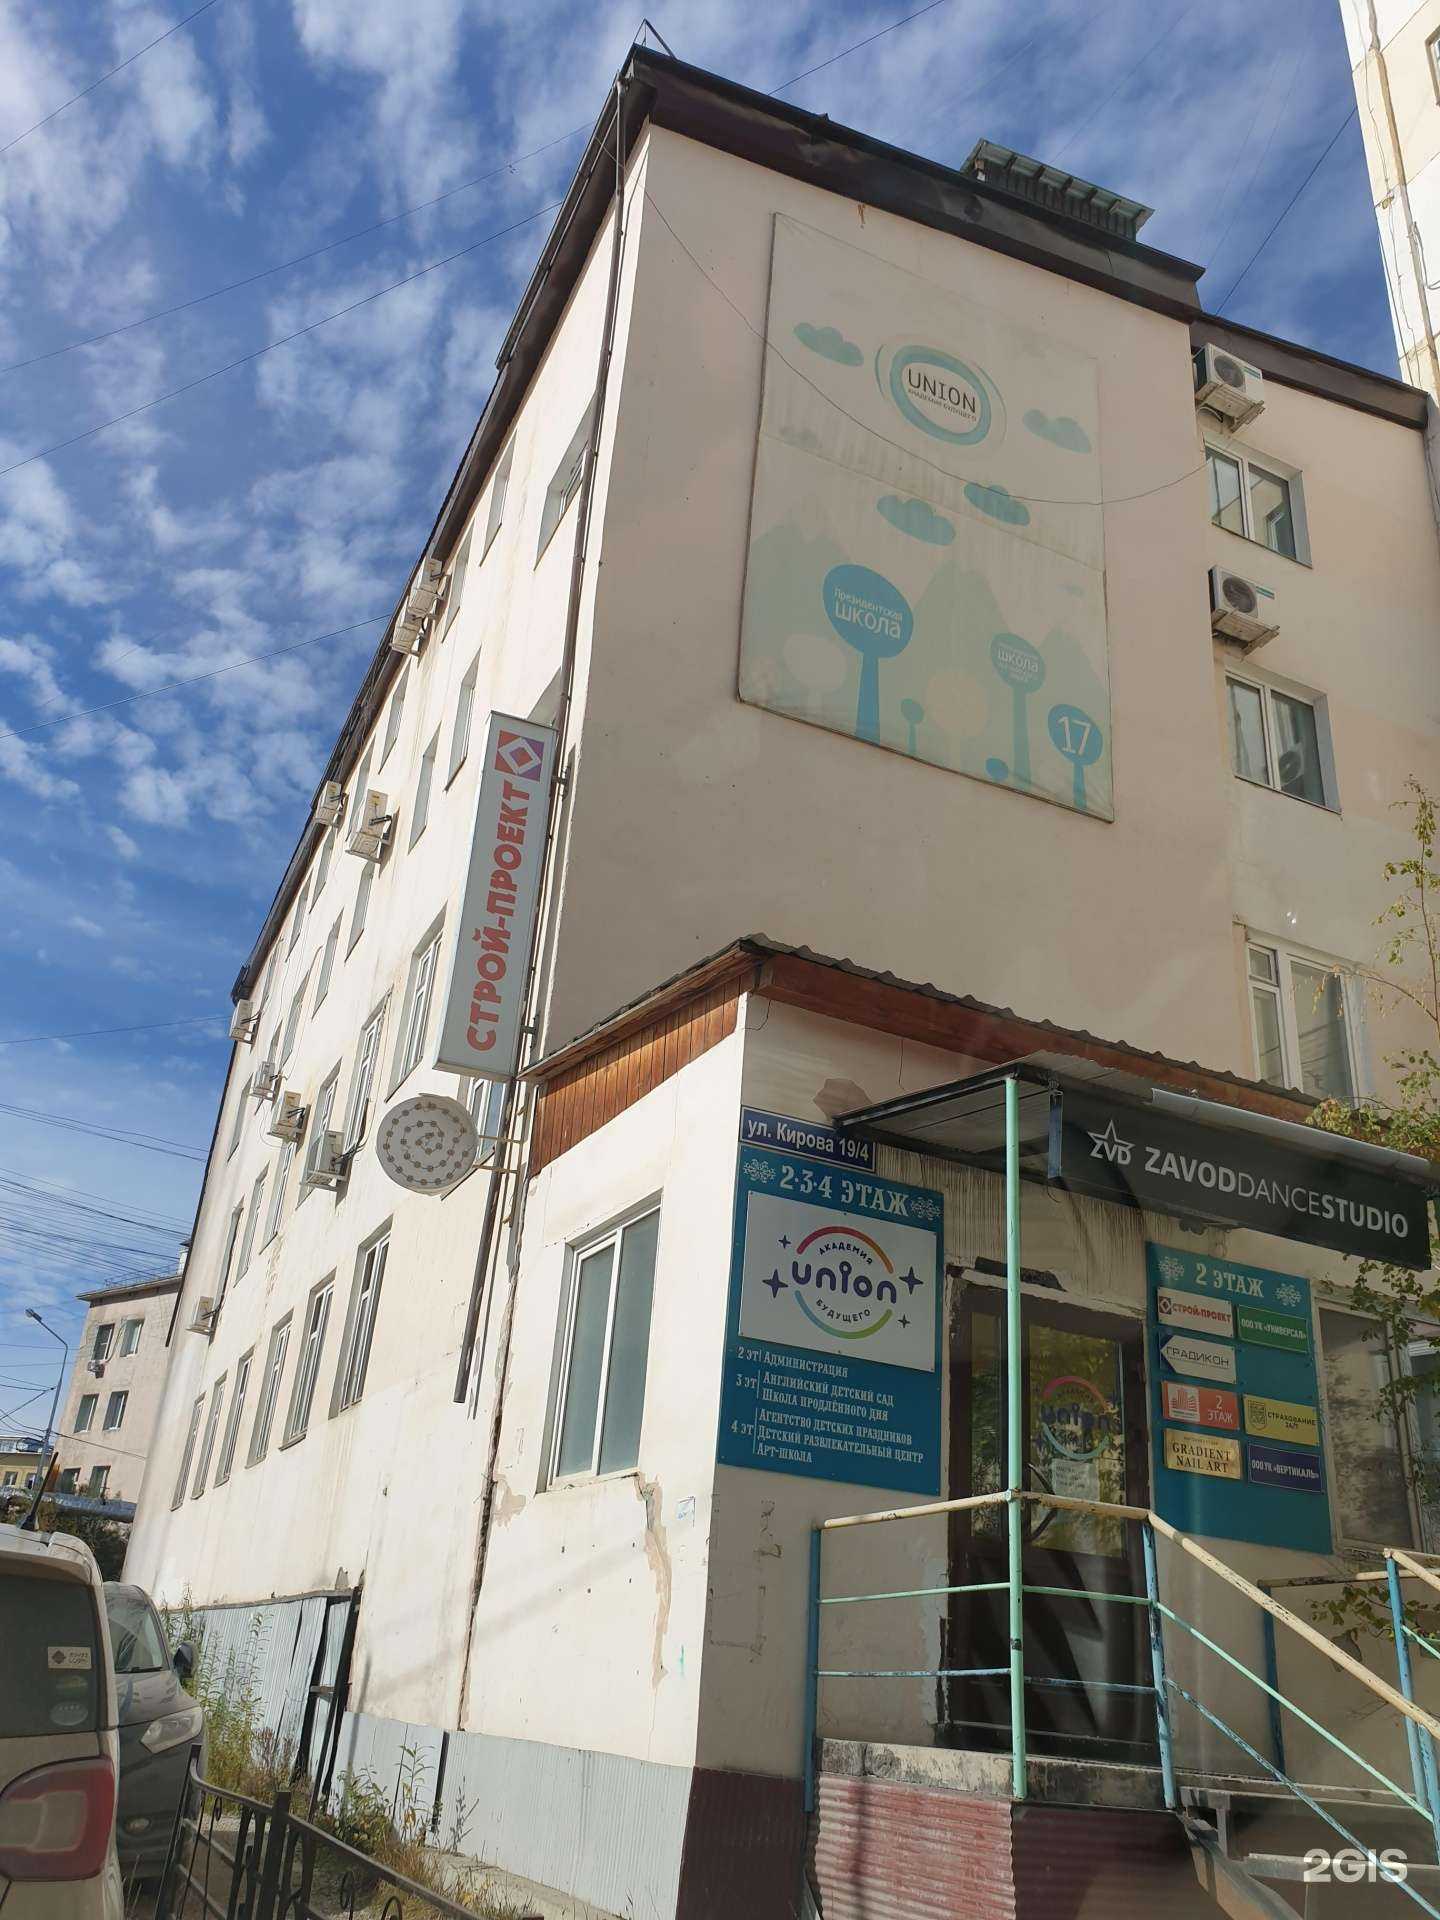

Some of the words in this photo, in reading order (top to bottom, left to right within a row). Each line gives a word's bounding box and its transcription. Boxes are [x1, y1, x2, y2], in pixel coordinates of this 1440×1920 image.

[908, 368, 977, 414] UNION
[1056, 714, 1090, 755] 17
[465, 778, 531, 1051] СТРОЙ-ПРОЕКТ
[747, 1118, 772, 1138] ул.
[776, 1122, 835, 1153] Кирова
[838, 1138, 870, 1161] 19/4
[840, 1180, 909, 1216] ЭТАЖ
[818, 1242, 873, 1265] АКАДЕМИЯ
[1196, 1263, 1208, 1286] 2
[1213, 1270, 1265, 1298] ЭТАЖ
[815, 1297, 871, 1323] БУДУЩЕГО
[1172, 1302, 1231, 1324] СТРОЙ-ПРОЕКТ
[737, 1346, 745, 1359] 2
[763, 1351, 849, 1378] АДМИНИСТРАЦИЯ
[735, 1373, 743, 1386] 3
[762, 1372, 829, 1395] АНГЛИЙСКИЙ
[830, 1386, 874, 1402] ДЕТСКИЙ
[876, 1394, 895, 1408] САД
[762, 1388, 798, 1405] ШКОЛА
[868, 1408, 888, 1421] ДНЯ
[1215, 1395, 1223, 1410] 2
[731, 1420, 740, 1433] 4
[759, 1408, 811, 1428] АГЕНТСТВО
[812, 1418, 854, 1436] ДЕТСКИХ
[856, 1426, 912, 1445] ПРАЗДНИКОВ
[1207, 1409, 1233, 1424] ЭТАЖ
[757, 1425, 801, 1444] ДЕТСКИЙ
[894, 1450, 924, 1464] ЦЕНТР
[757, 1442, 812, 1463] АРТ-ШКОЛА
[1171, 1441, 1232, 1461] GRADIENT
[1176, 1455, 1204, 1470] NAIL
[1205, 1461, 1229, 1473] ART
